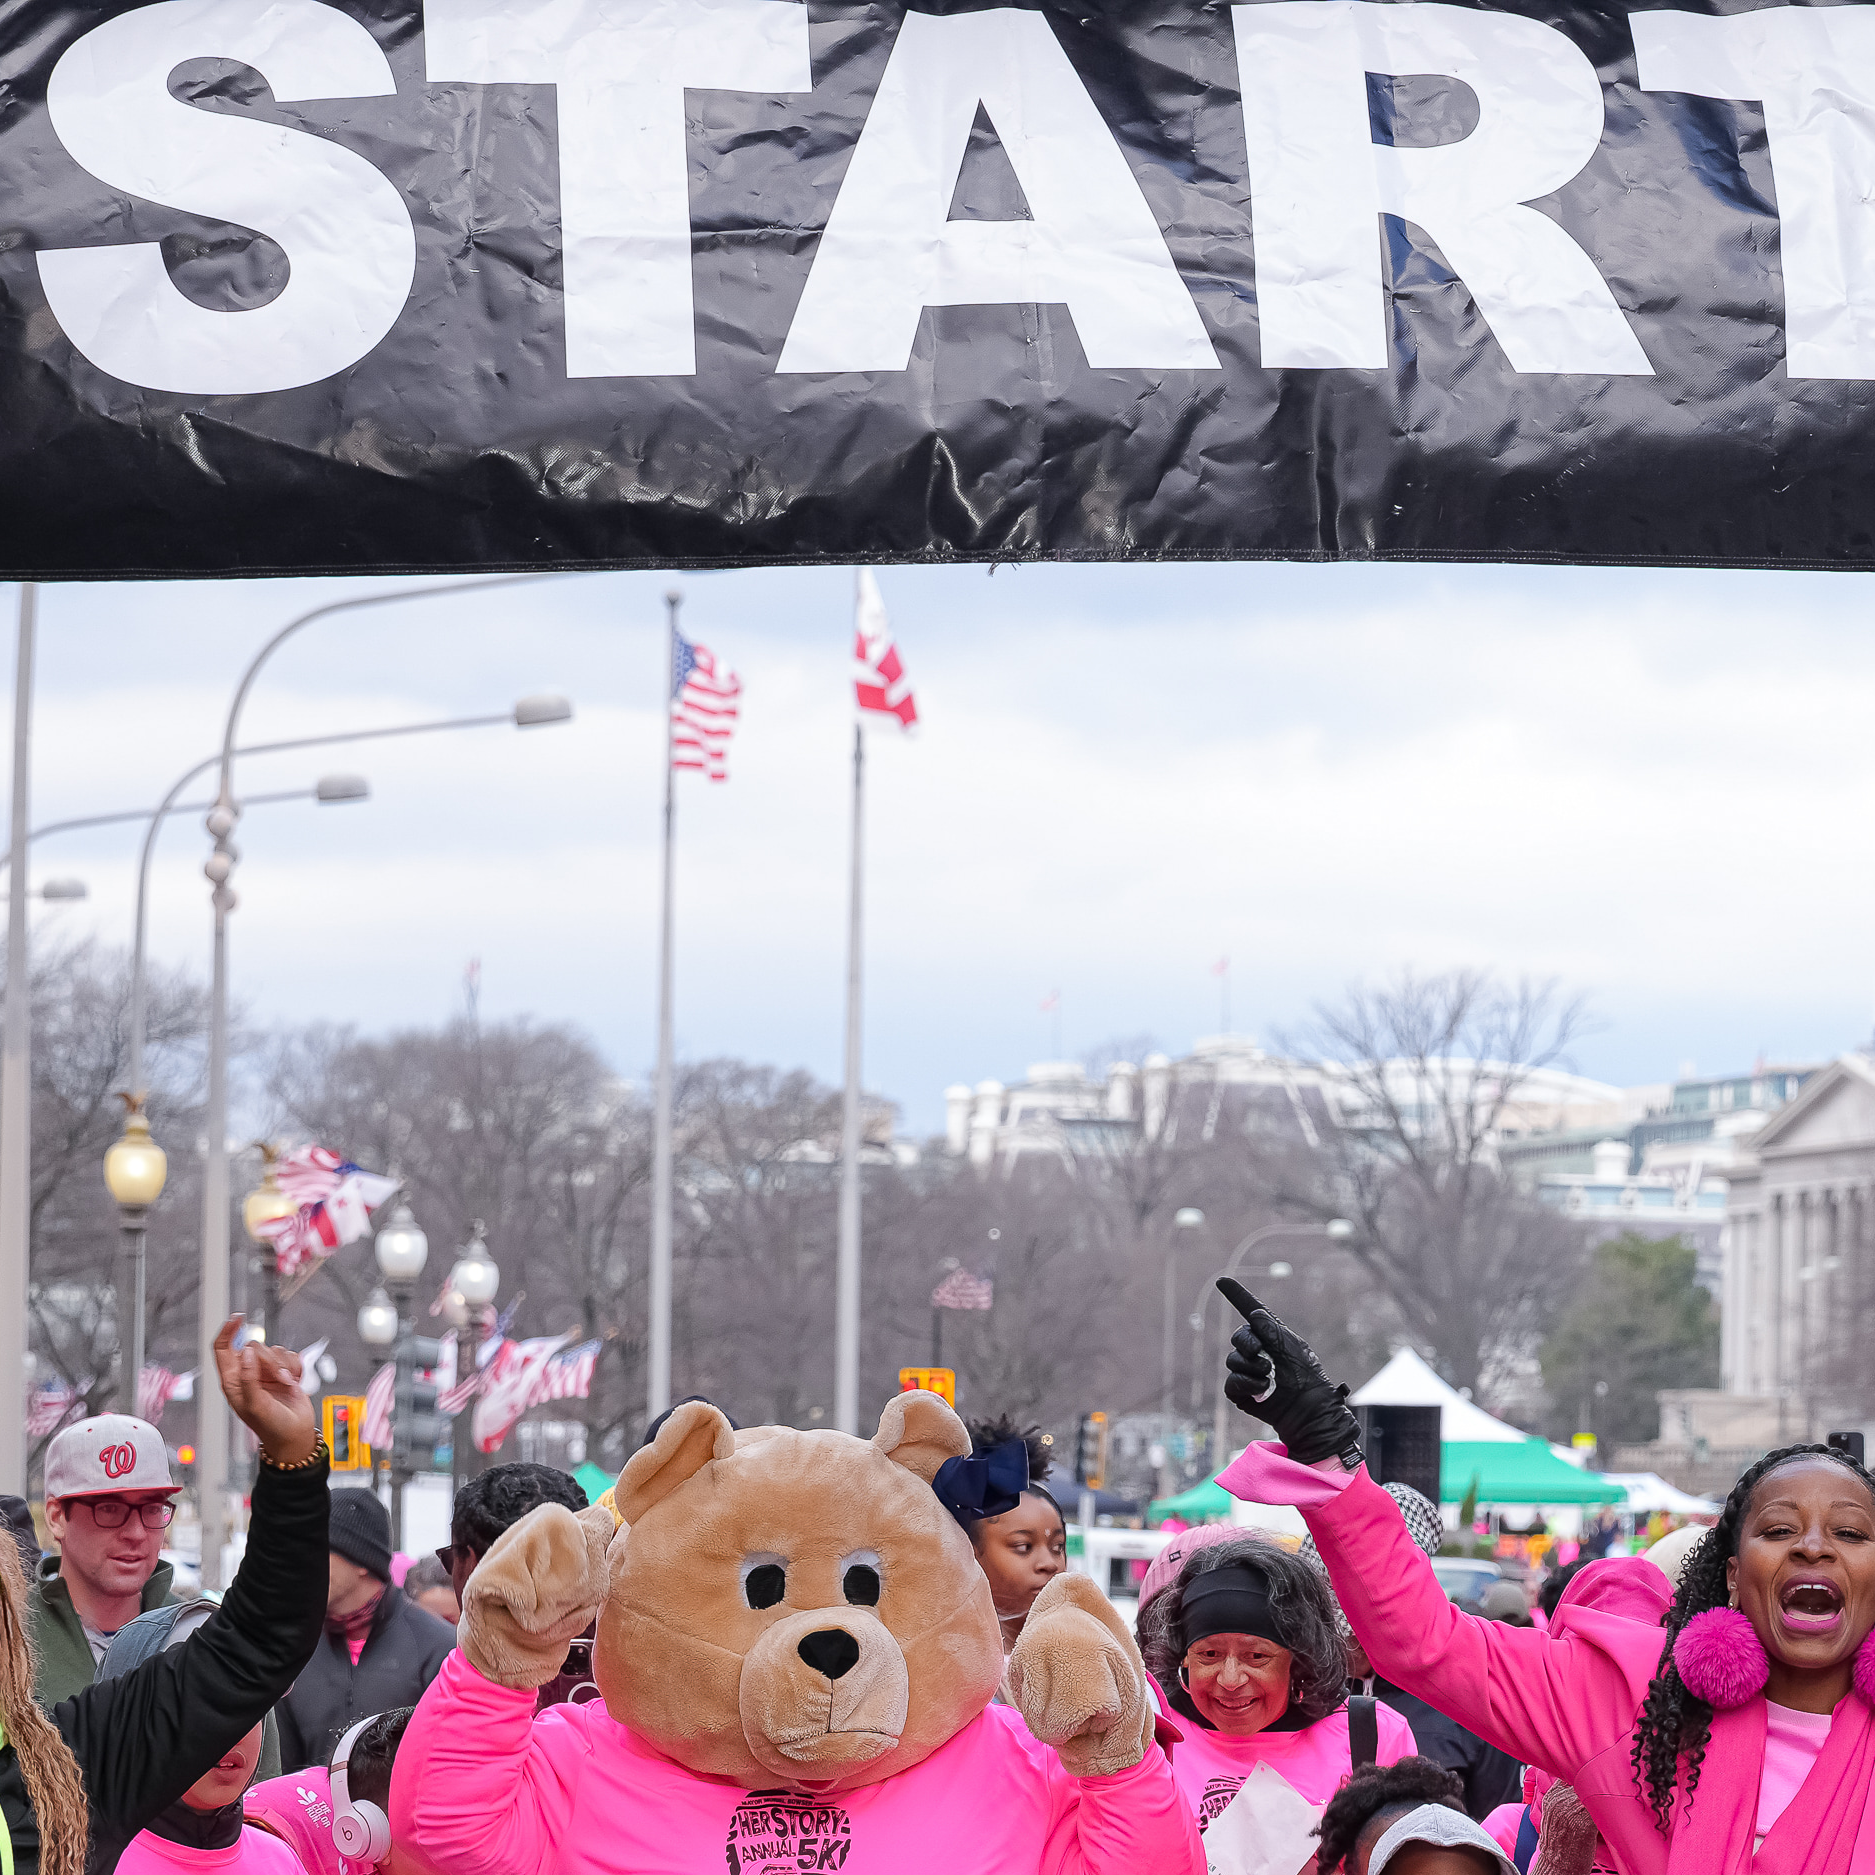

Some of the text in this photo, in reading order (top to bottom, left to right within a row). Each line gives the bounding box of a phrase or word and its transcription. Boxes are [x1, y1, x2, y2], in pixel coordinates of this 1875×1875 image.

[99, 1441, 137, 1479] W
[737, 1808, 845, 1838] HERSTORY
[741, 1838, 842, 1870] ANNUAL 5K
